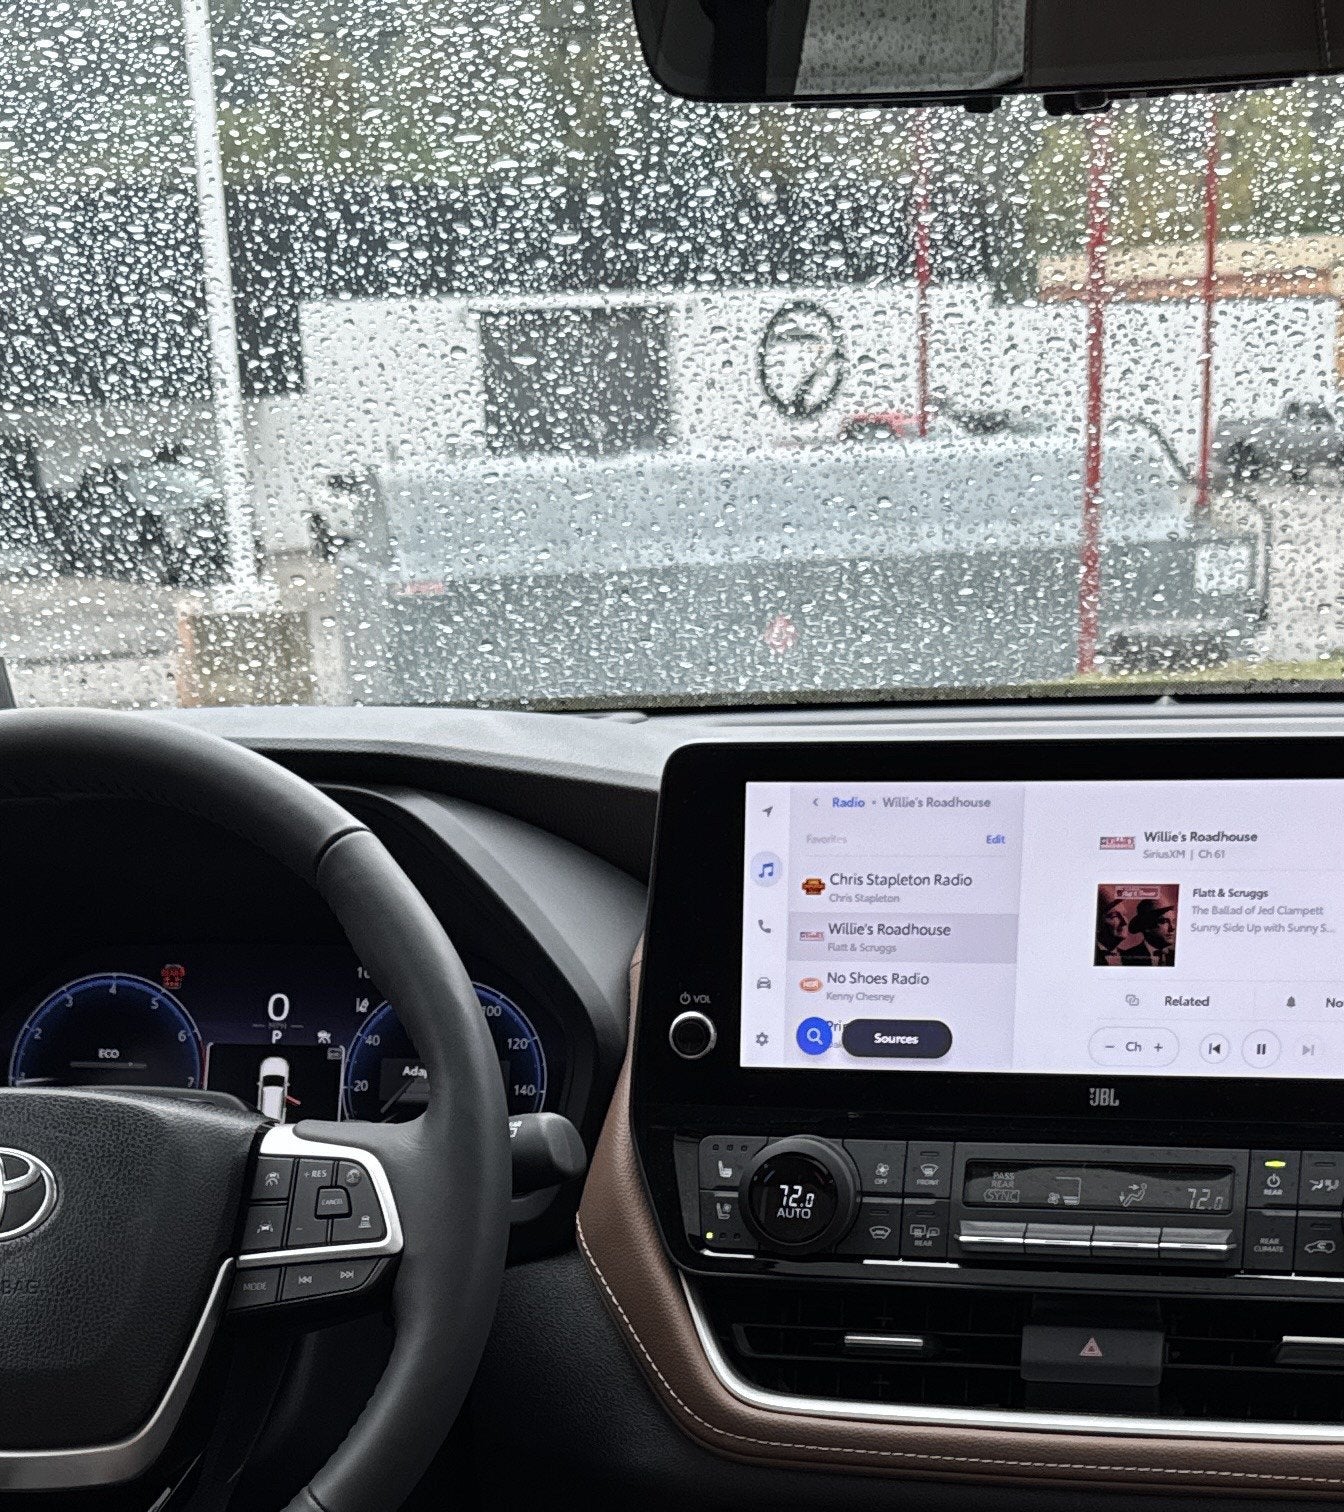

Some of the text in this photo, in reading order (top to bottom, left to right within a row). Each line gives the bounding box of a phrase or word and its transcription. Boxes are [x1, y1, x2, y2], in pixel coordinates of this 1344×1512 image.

[832, 796, 991, 809] Radio Willie's Roadhouse
[986, 834, 1006, 845] Edit
[1144, 831, 1187, 843] Willie's
[1190, 831, 1258, 843] Roadhouse
[1142, 849, 1186, 859] SiriusXM
[829, 872, 973, 890] Chris Stapleton Radio
[828, 893, 900, 905] Chris Stapleton
[1192, 888, 1269, 901] Flatt & Scruggs
[1191, 905, 1324, 918] The Ballad of Jed Clampett
[828, 922, 874, 937] Willie's
[876, 923, 952, 937] Roadhouse
[1190, 923, 1220, 935] Sunny
[1223, 922, 1244, 934] Side
[1246, 923, 1262, 936] Up
[1263, 923, 1285, 934] with
[1287, 923, 1318, 935] Sunny
[827, 942, 848, 953] Flatt
[859, 942, 897, 956] Scruggs
[826, 972, 930, 986] No Shoes Radio
[693, 994, 712, 1004] VOL
[825, 991, 895, 1004] Kenny Chesney
[1164, 996, 1210, 1008] Related
[267, 993, 290, 1021] 0
[271, 1030, 283, 1045] P
[365, 1035, 381, 1047] 40
[874, 1033, 919, 1046] Sources
[506, 1038, 528, 1050] 120
[1125, 1041, 1142, 1053] Ch
[98, 1048, 120, 1059] ECO
[353, 1080, 369, 1092] 20
[513, 1084, 535, 1096] 140
[1090, 1088, 1120, 1107] JBL
[992, 1171, 1015, 1181] PASS
[991, 1180, 1015, 1188] REAR
[779, 1184, 814, 1208] 72.0
[986, 1190, 1018, 1202] SYNC
[1187, 1188, 1223, 1211] 72.0
[776, 1207, 812, 1220] AUTO
[1259, 1237, 1281, 1245] REAR
[243, 1282, 267, 1291] MODE
